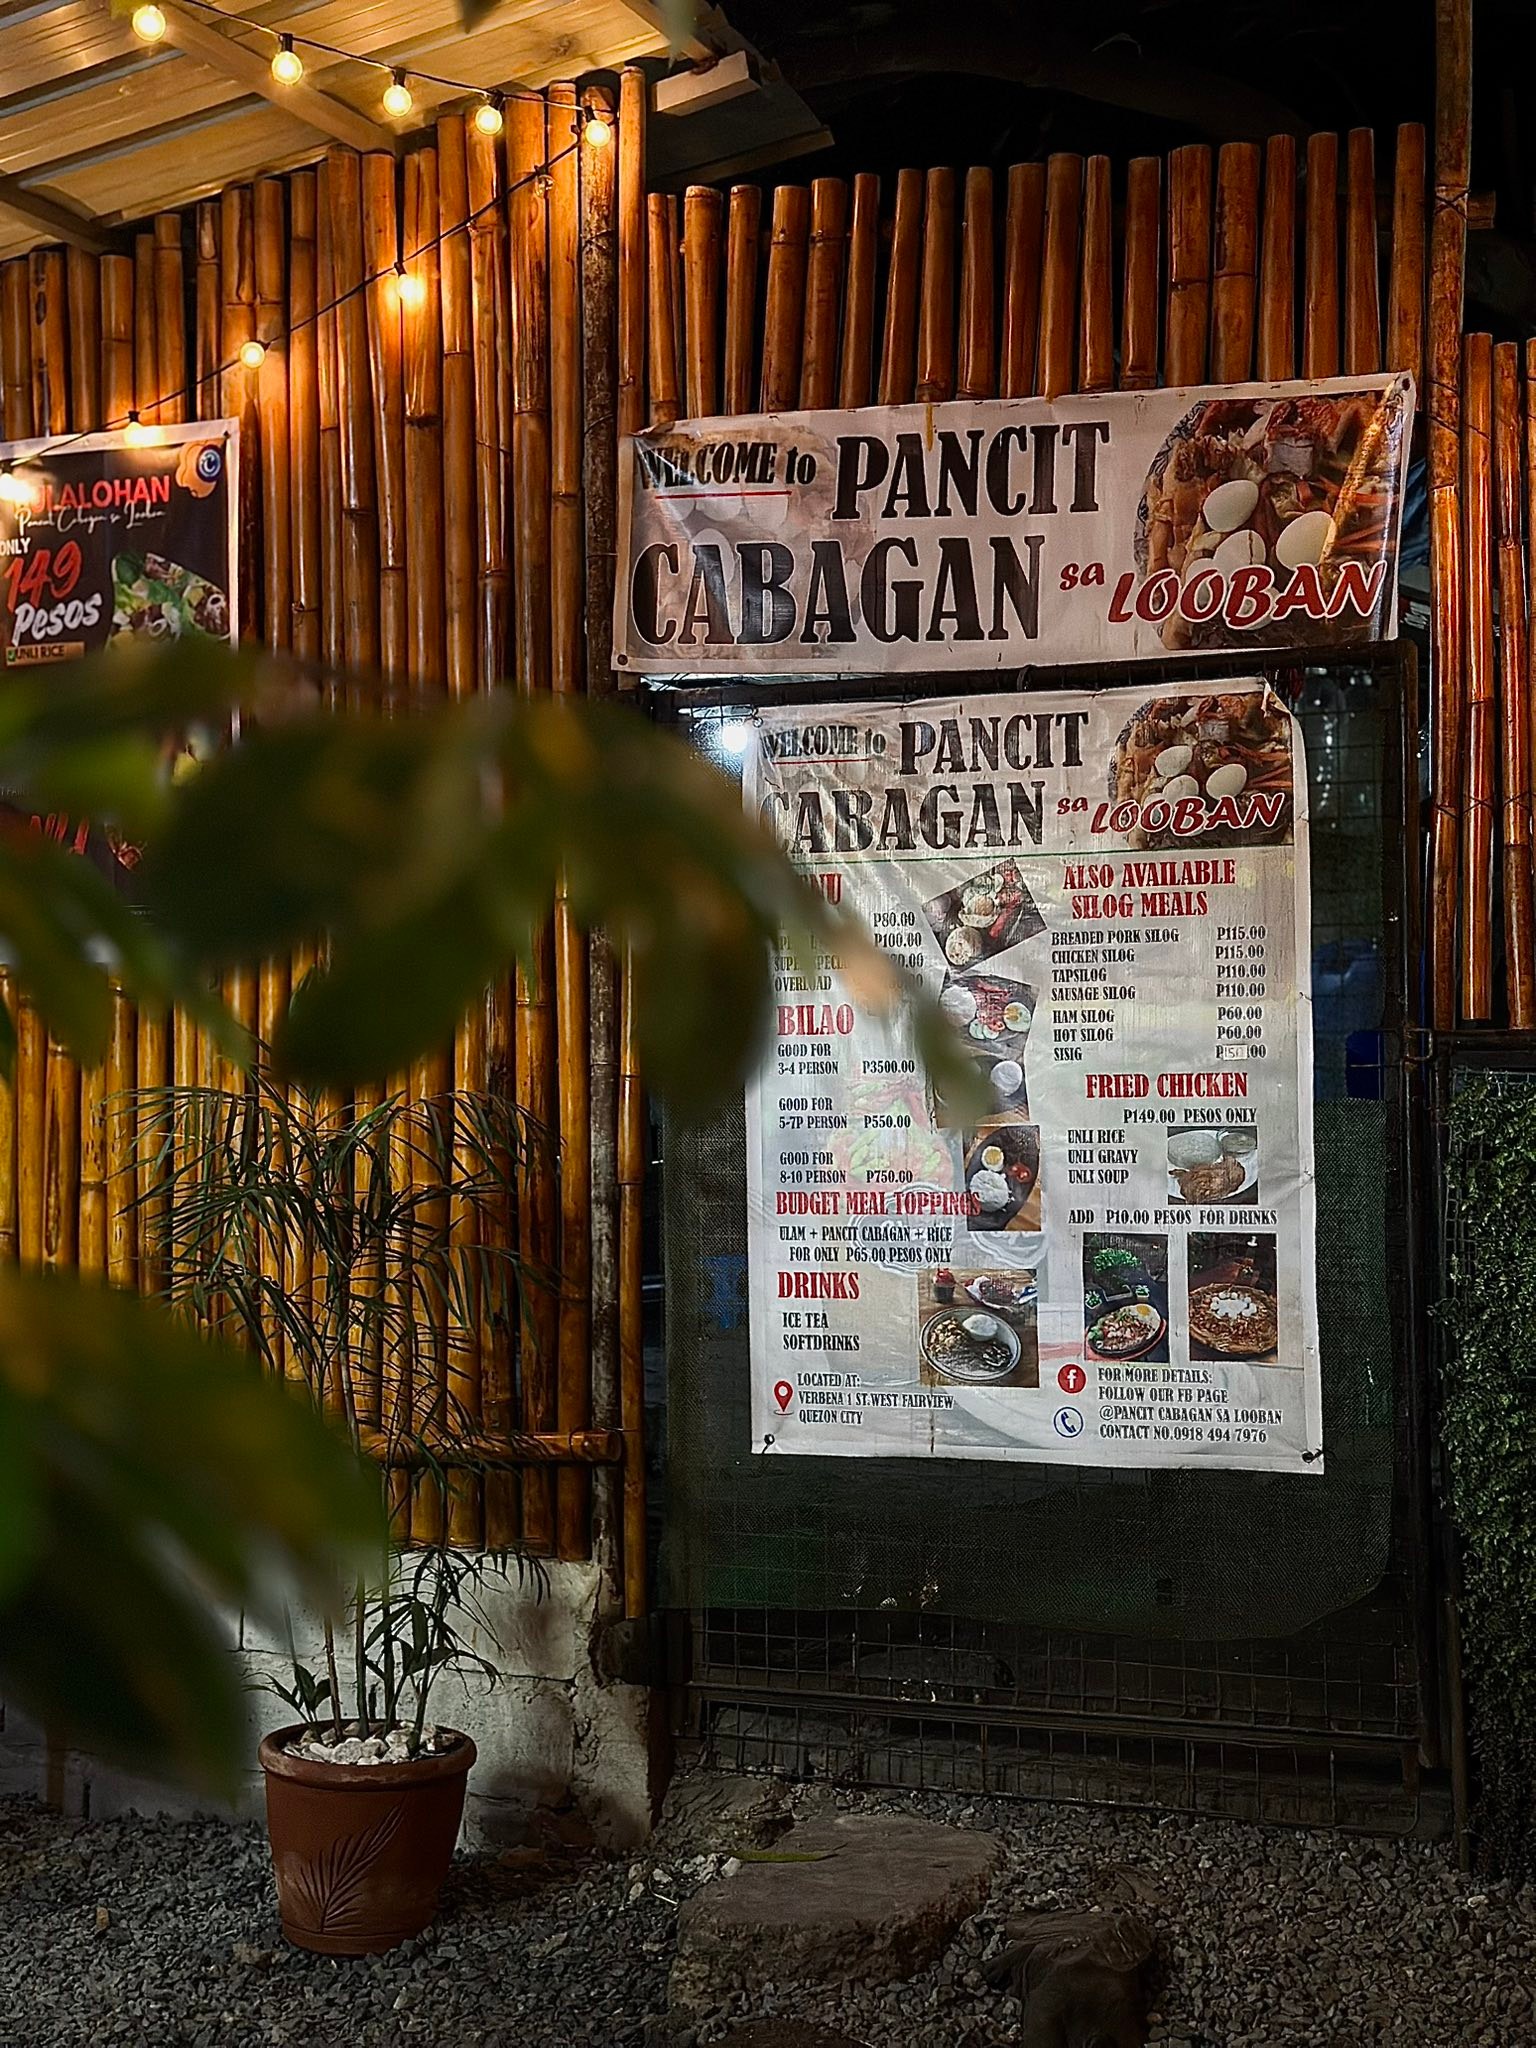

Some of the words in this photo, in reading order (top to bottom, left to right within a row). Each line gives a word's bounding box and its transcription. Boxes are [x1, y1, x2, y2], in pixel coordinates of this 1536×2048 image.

[638, 442, 778, 489] WELCOME
[785, 446, 816, 484] to
[831, 420, 1111, 521] PANCIT
[14, 475, 170, 514] ULALOHAN
[0, 538, 31, 556] ONLY
[4, 540, 82, 614] 149
[631, 534, 1045, 645] CABAGAN
[1059, 561, 1106, 591] sa
[1106, 560, 1387, 627] LOOBAN
[762, 726, 858, 759] WELCOME
[865, 729, 887, 753] to
[899, 712, 1089, 776] PANCIT
[1057, 797, 1089, 816] sa
[1090, 793, 1283, 836] LOOBAN
[1063, 864, 1114, 889] ALSO
[1121, 859, 1236, 888] AVAILABLE
[1072, 894, 1133, 919] SILOG
[1141, 891, 1208, 917] MEALS
[874, 912, 915, 927] P80.00
[875, 933, 922, 947] P100.00
[1051, 931, 1104, 945] BREADED
[1107, 930, 1141, 943] PORK
[1144, 929, 1179, 942] SILOG
[1217, 926, 1266, 941] P115.00
[1051, 950, 1099, 963] CHICKEN
[1101, 949, 1135, 962] SILOG
[1215, 945, 1264, 959] P115.00
[1051, 968, 1107, 982] TAPSILOG
[1216, 964, 1266, 978] P110.00
[1051, 987, 1100, 1001] SAUSAGE
[1103, 986, 1136, 1000] SILOG
[1216, 983, 1265, 997] P110.00
[777, 1004, 854, 1036] BILAO
[1053, 1010, 1077, 1024] HAM
[1081, 1009, 1115, 1023] SILOG
[1217, 1006, 1263, 1020] P60.00
[1053, 1028, 1077, 1042] HOT
[1080, 1028, 1114, 1041] SILOG
[1217, 1025, 1262, 1039] P60.00
[778, 1044, 808, 1057] GOOD
[811, 1044, 831, 1056] FOR
[1054, 1047, 1083, 1061] SISIG
[778, 1063, 795, 1075] 3-4
[799, 1062, 839, 1075] PERSON
[1086, 1074, 1149, 1098] FRIED
[1156, 1072, 1248, 1098] CHICKEN
[779, 1098, 808, 1111] GOOD
[812, 1098, 833, 1111] FOR
[779, 1116, 804, 1129] 5-7P
[807, 1116, 848, 1129] PERSON
[864, 1115, 911, 1128] P550.00
[1123, 1109, 1176, 1123] P149.00
[1184, 1109, 1222, 1123] PESOS
[1226, 1108, 1257, 1123] ONLY
[1068, 1130, 1094, 1144] UNLI
[1097, 1130, 1125, 1144] RICE
[780, 1152, 809, 1165] GOOD
[812, 1152, 834, 1165] FOR
[1068, 1150, 1094, 1164] UNLI
[1097, 1150, 1138, 1164] GRAVY
[780, 1170, 803, 1184] 8-10
[806, 1170, 846, 1184] PERSON
[866, 1170, 913, 1184] P750.00
[1068, 1170, 1095, 1184] UNLI
[1097, 1170, 1129, 1184] SOUP
[776, 1192, 841, 1216] BUDGET
[846, 1192, 889, 1216] MEAL
[893, 1192, 982, 1216] TOPPINGS
[1068, 1210, 1095, 1224] ADD
[1106, 1210, 1150, 1224] P10.00
[1154, 1210, 1192, 1224] PESOS
[1199, 1210, 1225, 1225] FOR
[1229, 1210, 1277, 1224] DRINKS
[779, 1227, 806, 1241] ULAM
[822, 1227, 859, 1241] PANCIT
[862, 1227, 911, 1241] CABAGAN
[927, 1227, 952, 1241] RICE
[789, 1247, 811, 1262] FOR
[814, 1247, 839, 1262] ONLY
[846, 1247, 886, 1262] P65.00
[889, 1247, 922, 1262] PESOS
[925, 1247, 952, 1262] ONLY
[777, 1272, 860, 1299] DRINKS
[782, 1313, 802, 1328] ICE
[805, 1313, 829, 1328] TEA
[783, 1335, 860, 1350] SOFTDRINKS
[797, 1373, 842, 1386] LOCATED
[845, 1374, 861, 1386] AT:
[1098, 1368, 1121, 1381] FOR
[1125, 1368, 1158, 1382] MORE
[1162, 1369, 1213, 1384] DETAILS:
[798, 1391, 844, 1404] VERBENA
[902, 1394, 954, 1408] FAIRVIEW
[1098, 1386, 1145, 1401] FOLLOW
[1149, 1388, 1173, 1401] OUR
[1177, 1389, 1193, 1402] FB
[1198, 1389, 1228, 1403] PAGE
[799, 1410, 837, 1423] QUEZON
[840, 1411, 863, 1424] CITY
[1100, 1406, 1154, 1420] @PANCIT
[1158, 1407, 1213, 1422] CABAGAN
[1216, 1409, 1230, 1423] SA
[1234, 1410, 1282, 1424] LOOBAN
[1100, 1425, 1150, 1439] CONTACT
[1207, 1428, 1231, 1441] 494
[1235, 1428, 1266, 1442] 7976
